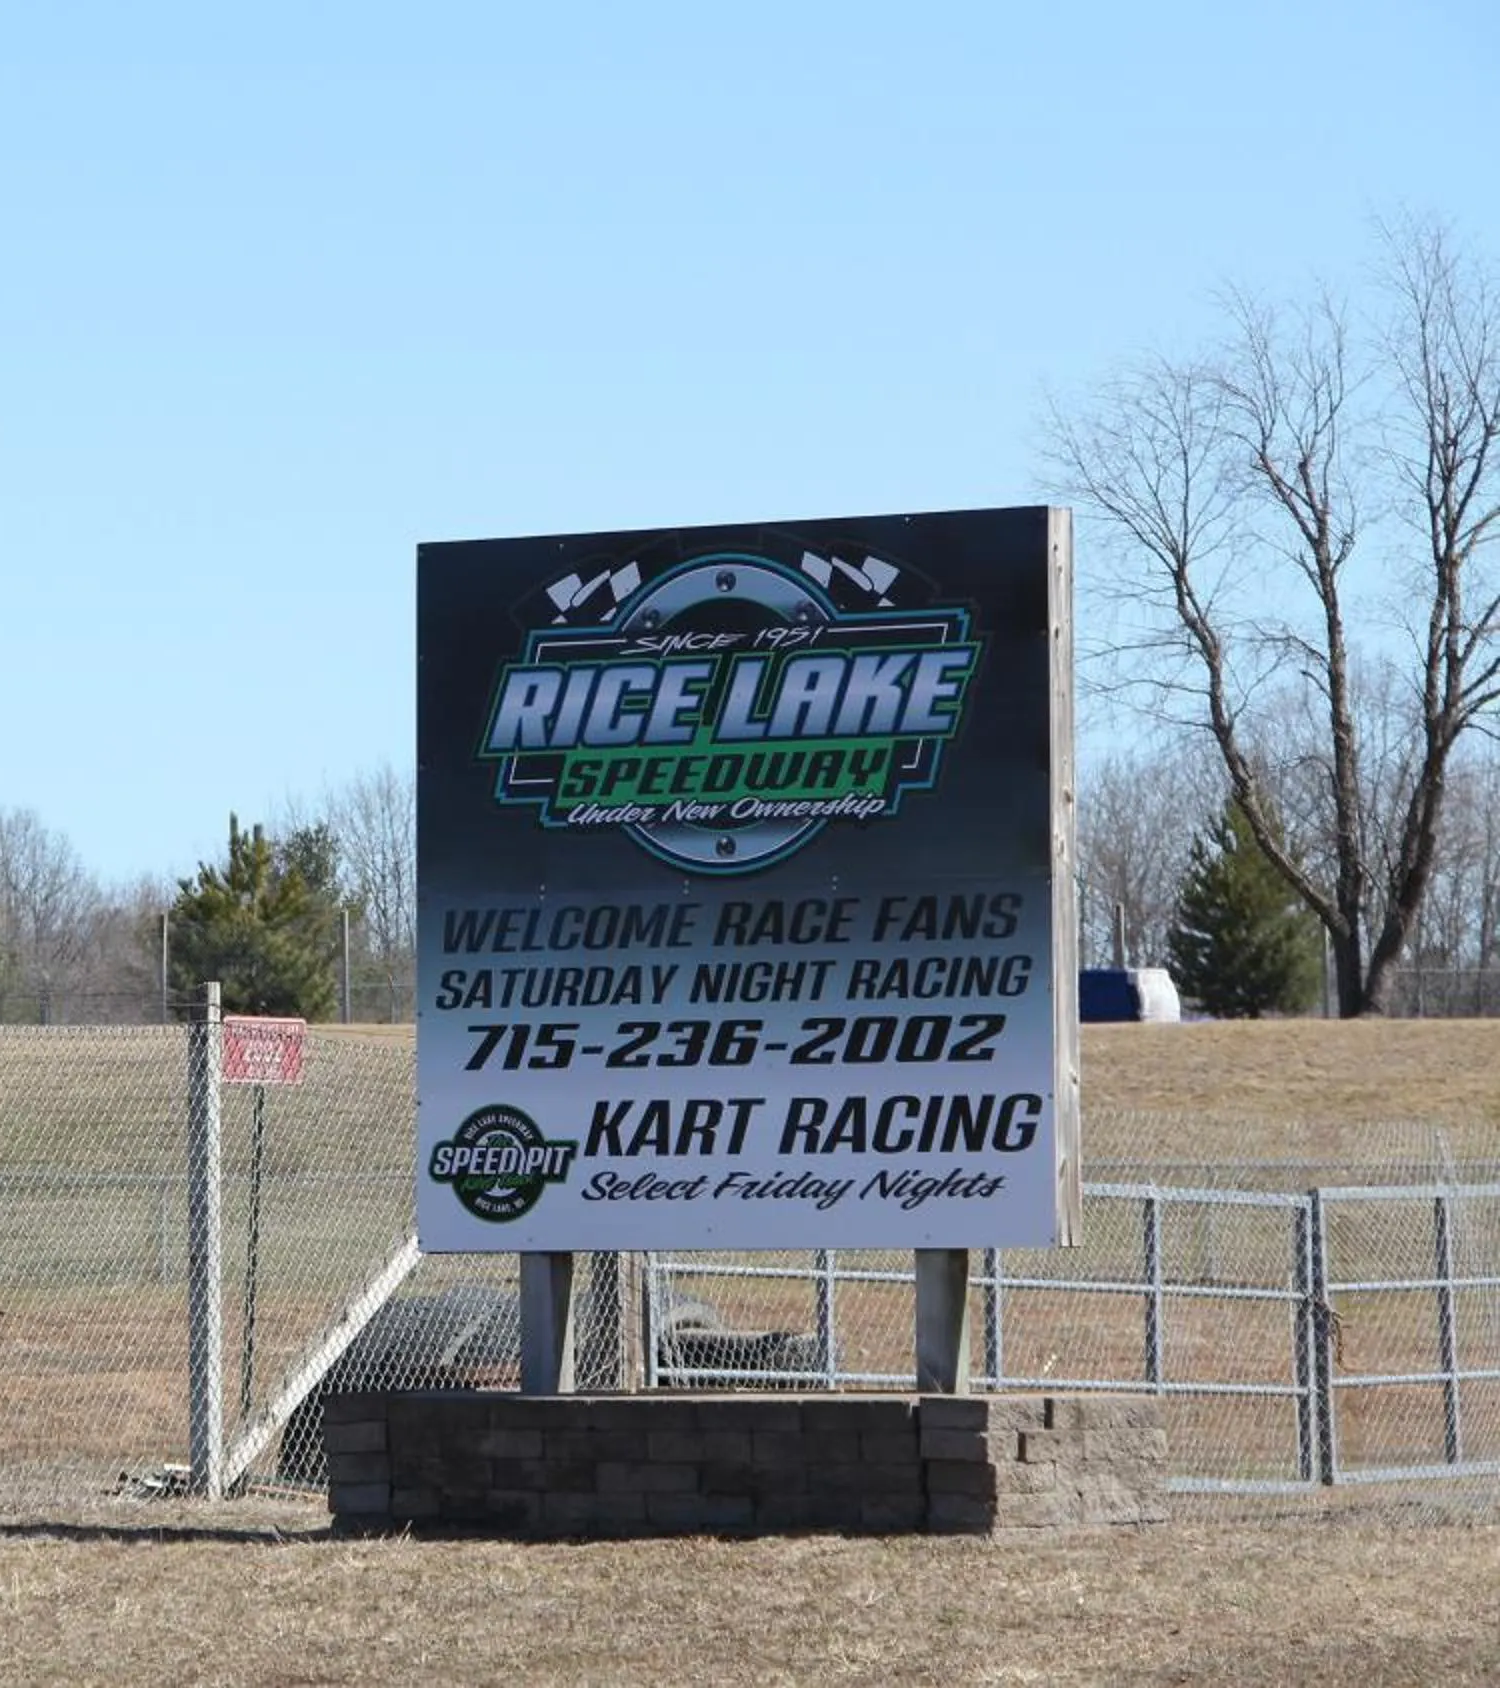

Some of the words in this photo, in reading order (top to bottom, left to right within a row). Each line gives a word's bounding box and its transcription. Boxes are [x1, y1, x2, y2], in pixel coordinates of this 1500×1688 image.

[619, 631, 749, 656] SINCE
[752, 625, 824, 649] 1951
[488, 663, 713, 749] RICE
[716, 648, 972, 741] LAKE
[561, 748, 888, 798] SPEEDWAY
[567, 802, 656, 825] Under
[661, 799, 728, 823] New
[730, 791, 887, 820] Ownership
[442, 902, 697, 955] WELCOME
[712, 896, 860, 948] RACE
[870, 892, 1024, 942] FANS
[435, 963, 680, 1011] SATURDAY
[689, 958, 837, 1003] NIGHT
[845, 954, 1034, 999] RACING
[463, 1014, 1007, 1071] 715-236-2002
[582, 1096, 766, 1157] KART
[777, 1092, 1043, 1155] RACING
[433, 1146, 519, 1176] SPEED
[525, 1146, 571, 1176] PIT
[580, 1170, 708, 1202] Select
[713, 1168, 855, 1211] Friday
[860, 1166, 1006, 1210] Nights
